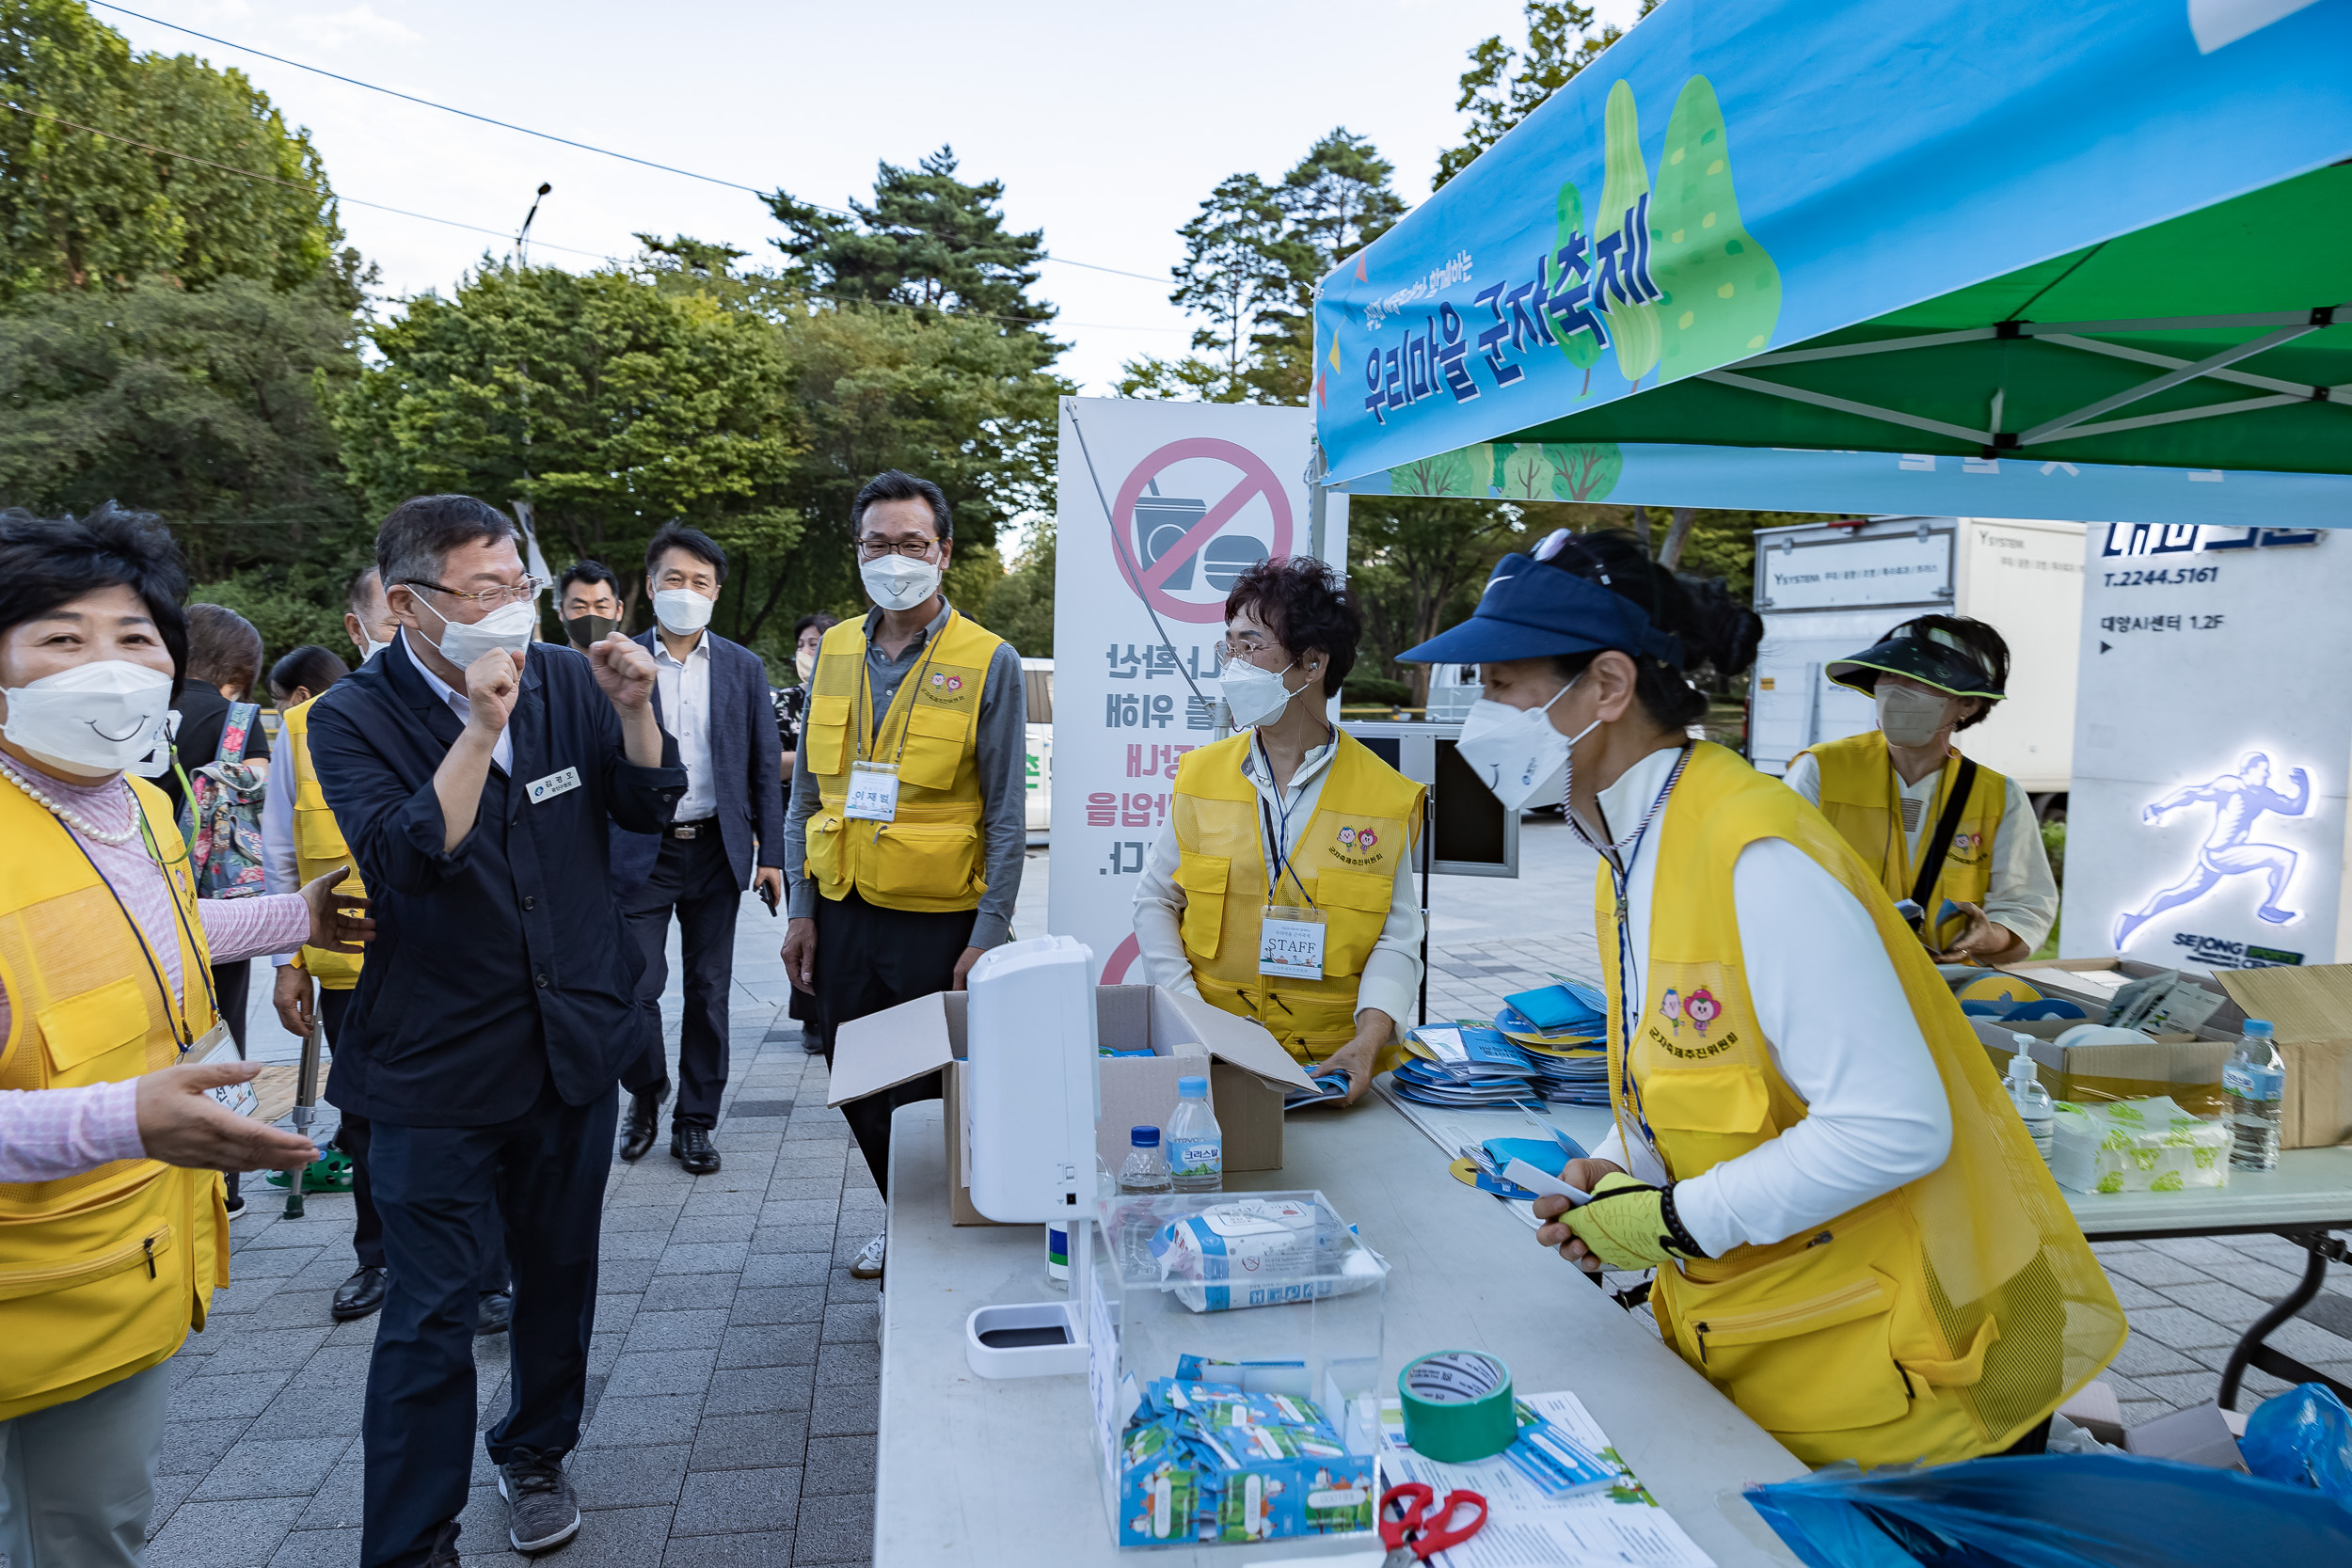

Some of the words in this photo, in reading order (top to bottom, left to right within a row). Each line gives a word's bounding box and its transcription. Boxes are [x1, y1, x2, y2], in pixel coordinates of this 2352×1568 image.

[1364, 301, 1481, 426] 우리마을
[1474, 192, 1664, 388] 군자축제
[2104, 566, 2219, 587] T.2244.5161
[2101, 614, 2181, 633] 대양AI센터
[1328, 846, 1384, 866] 군자축제추진위원회
[1268, 938, 1317, 954] STAFF
[2172, 932, 2243, 955] SEJONG
[1648, 1026, 1739, 1060] 군자축제추진위원회
[1184, 1148, 1218, 1160] 크리스탈
